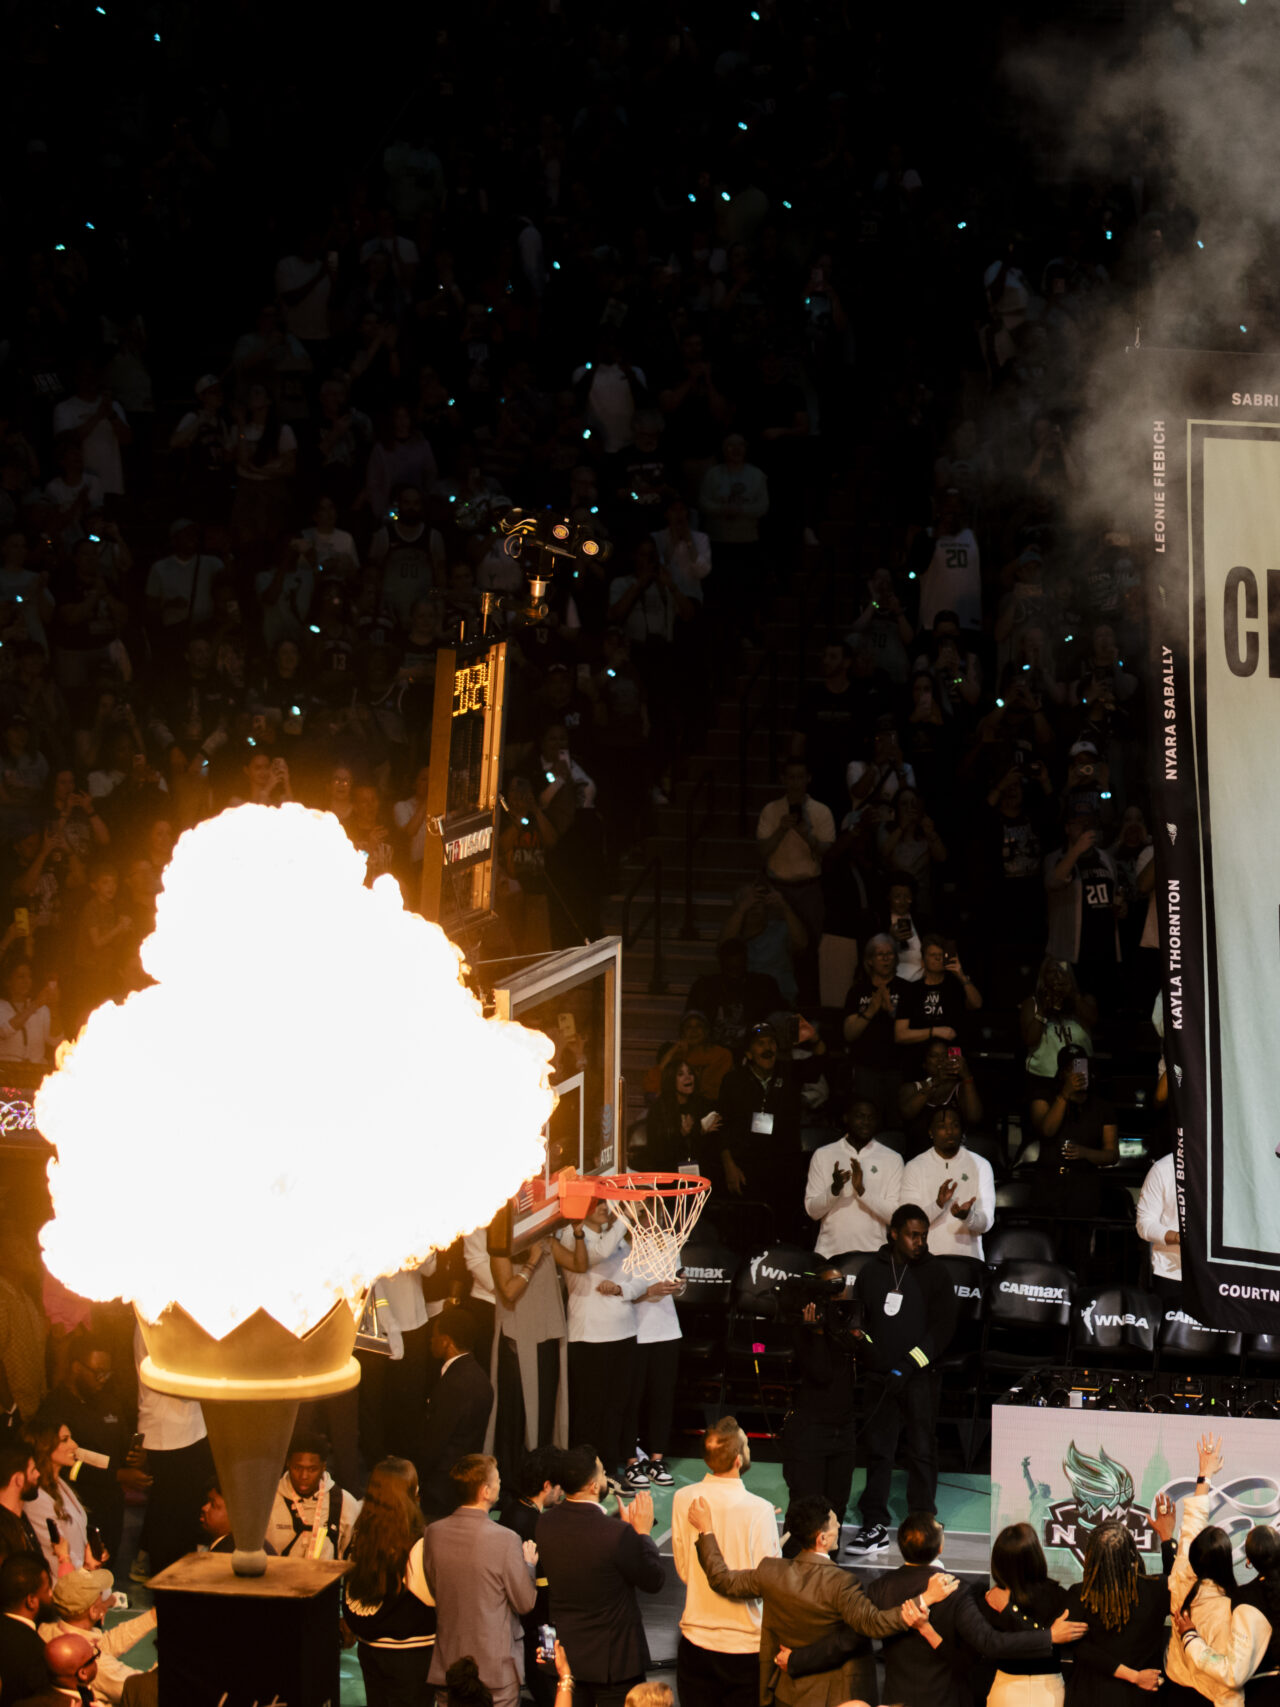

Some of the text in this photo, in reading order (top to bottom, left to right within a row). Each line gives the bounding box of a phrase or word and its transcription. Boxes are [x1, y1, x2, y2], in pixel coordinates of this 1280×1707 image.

[1152, 420, 1166, 553] LEONIE FIEBICH
[946, 549, 968, 568] 20
[1161, 645, 1178, 780] NYARA SABALLY
[460, 827, 493, 859] TISSOT
[1085, 883, 1109, 904] 20
[1167, 879, 1183, 1030] KAYLA THORNTON
[1094, 1313, 1150, 1329] WNBA
